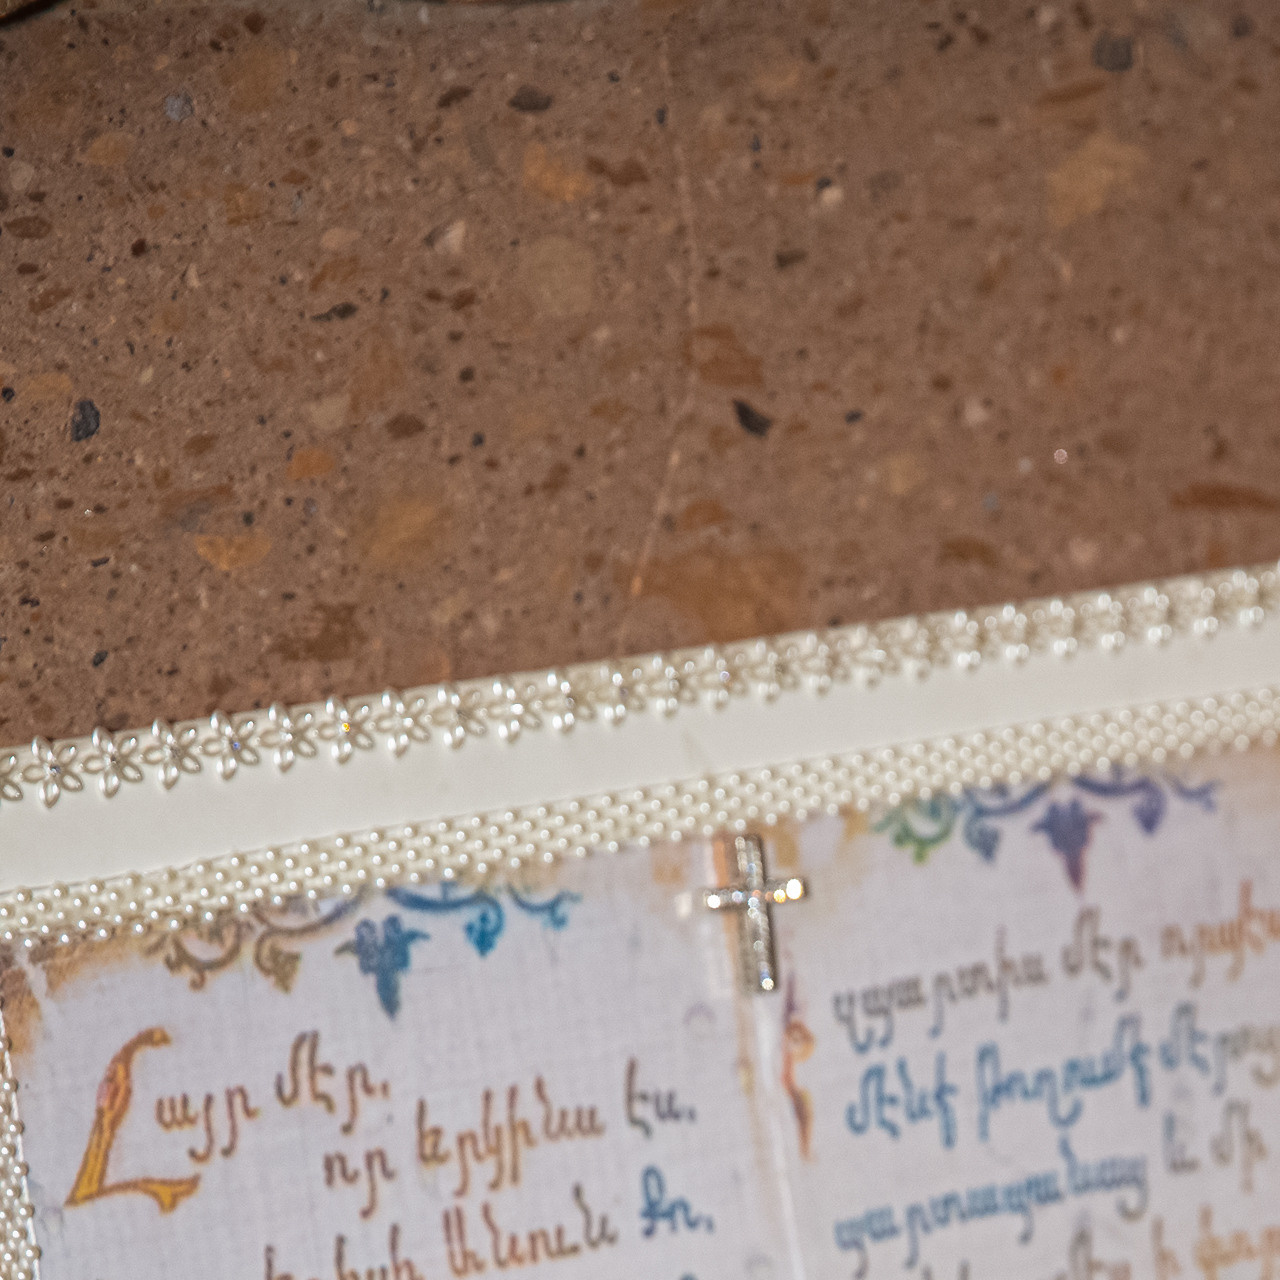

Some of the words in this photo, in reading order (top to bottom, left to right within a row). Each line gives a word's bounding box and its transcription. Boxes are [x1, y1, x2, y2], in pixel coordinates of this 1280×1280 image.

[832, 923, 1049, 1056] զպարտիս
[1061, 904, 1144, 1003] մէր
[323, 1147, 397, 1219] որ
[416, 1073, 605, 1198] երկինս
[1210, 1098, 1268, 1195] մի
[442, 1181, 618, 1278] Անուն
